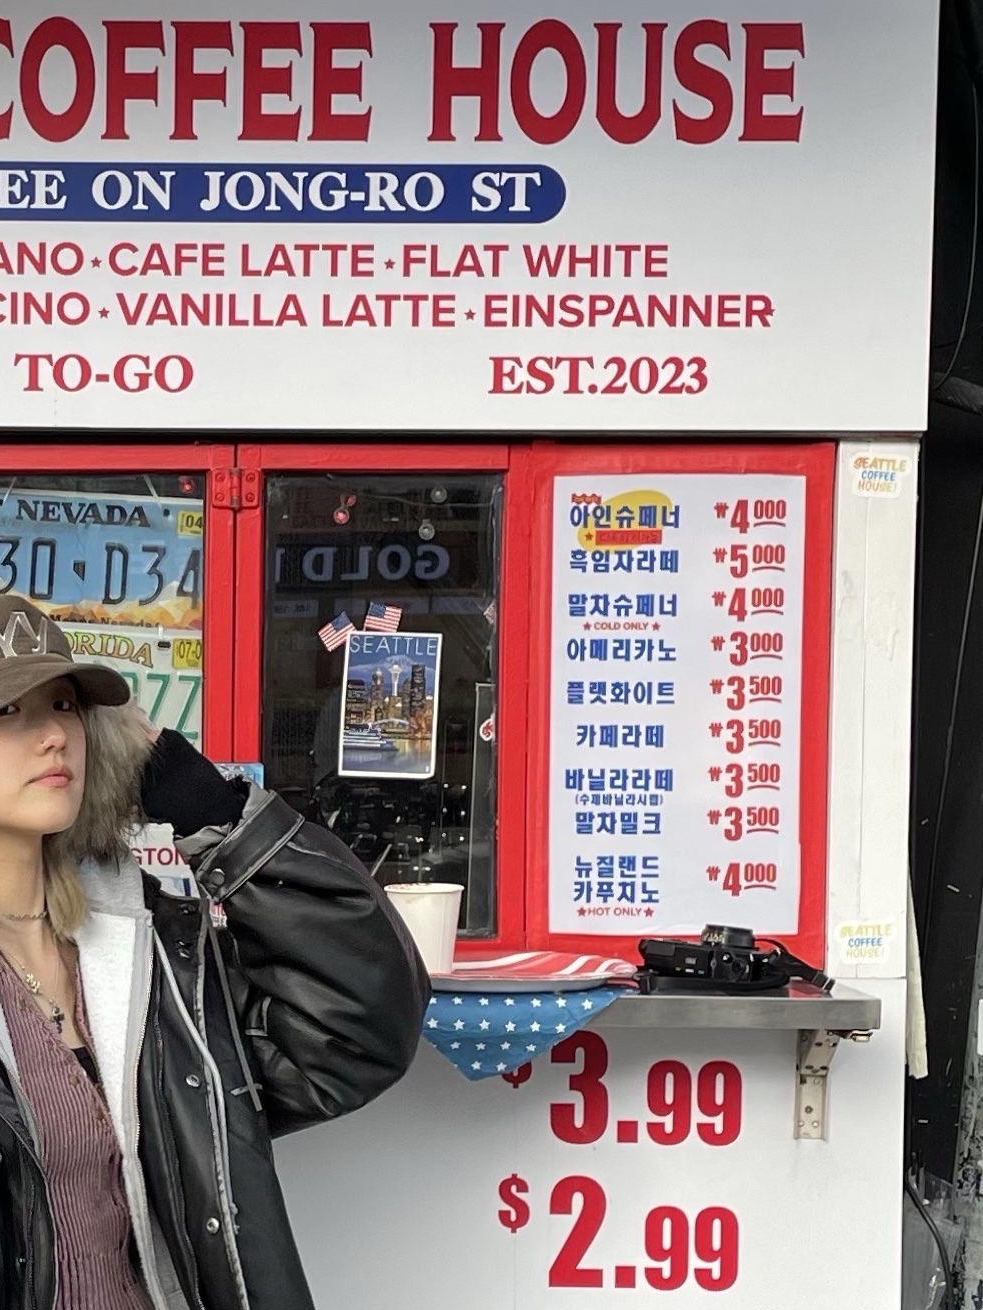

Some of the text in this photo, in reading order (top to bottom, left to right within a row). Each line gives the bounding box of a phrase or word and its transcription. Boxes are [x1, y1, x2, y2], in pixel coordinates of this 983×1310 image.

[427, 19, 805, 146] HOUSE
[91, 170, 176, 211] ON
[200, 169, 445, 213] JONG-RO
[470, 170, 542, 214] ST
[108, 243, 224, 277] CAFE
[241, 244, 374, 278] LATTE
[402, 244, 509, 278] FLAT
[524, 245, 668, 279] WHITE
[117, 293, 307, 328] VANILLA
[322, 294, 455, 328] LATTE
[483, 294, 773, 329] EINSPANNER
[14, 353, 195, 393] TO-GO
[488, 356, 709, 396] EST.2023
[853, 457, 907, 472] SEATTLE
[861, 470, 897, 482] COFFEE
[16, 499, 151, 528] NEVADA
[185, 514, 203, 529] 04
[569, 504, 681, 529] 아인슈페너
[569, 549, 681, 575] 흑임자라떼
[567, 593, 679, 619] 말차슈페너
[593, 621, 650, 631] COLD ONLY
[349, 635, 438, 657] SEATTLE
[566, 637, 677, 663] 아메리카노
[566, 680, 676, 706] 플랫화이트
[575, 723, 666, 749] 카페라떼
[564, 768, 675, 793] 바닐라라떼
[574, 811, 663, 836] 말차밀크
[574, 854, 661, 879] 뉴질랜드
[573, 880, 661, 905] 카푸치노
[587, 906, 643, 917] HOT ONLY
[847, 937, 884, 948] COFFEE
[497, 1174, 741, 1293] $2.99
